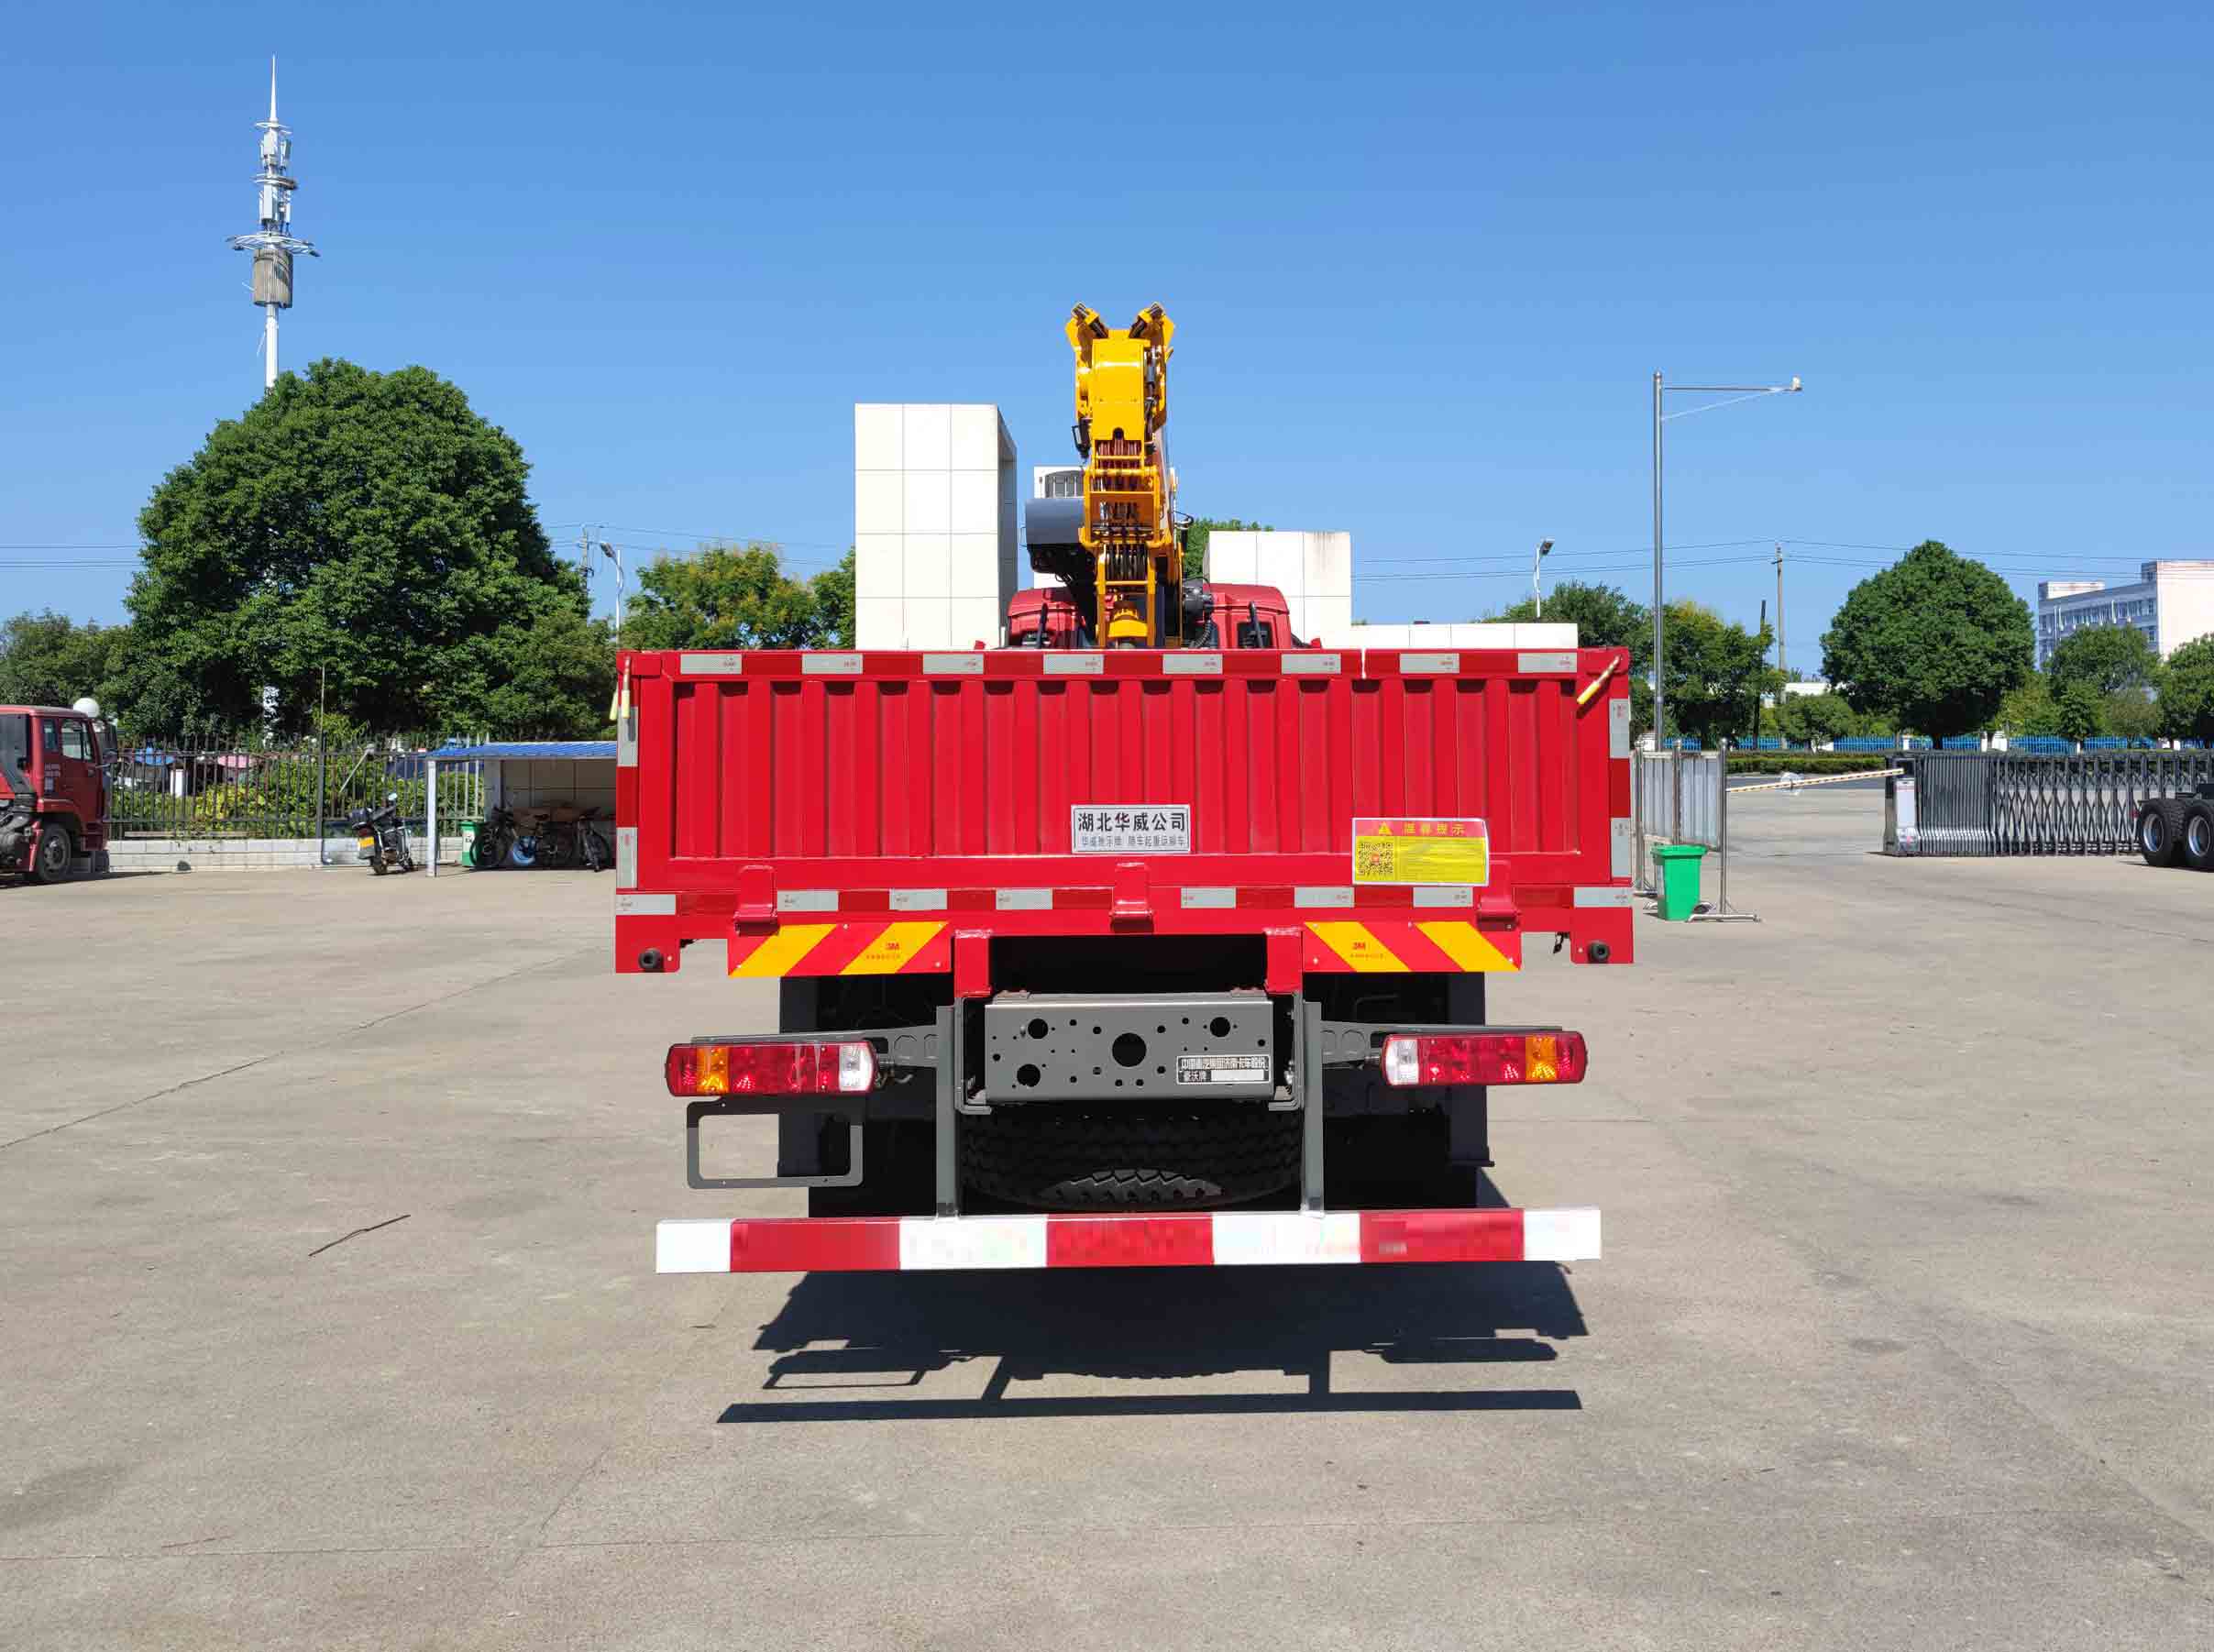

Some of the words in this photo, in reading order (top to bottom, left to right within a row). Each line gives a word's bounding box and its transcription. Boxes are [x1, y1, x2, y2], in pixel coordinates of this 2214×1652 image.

[1078, 812, 1185, 832] 湖北华威公司
